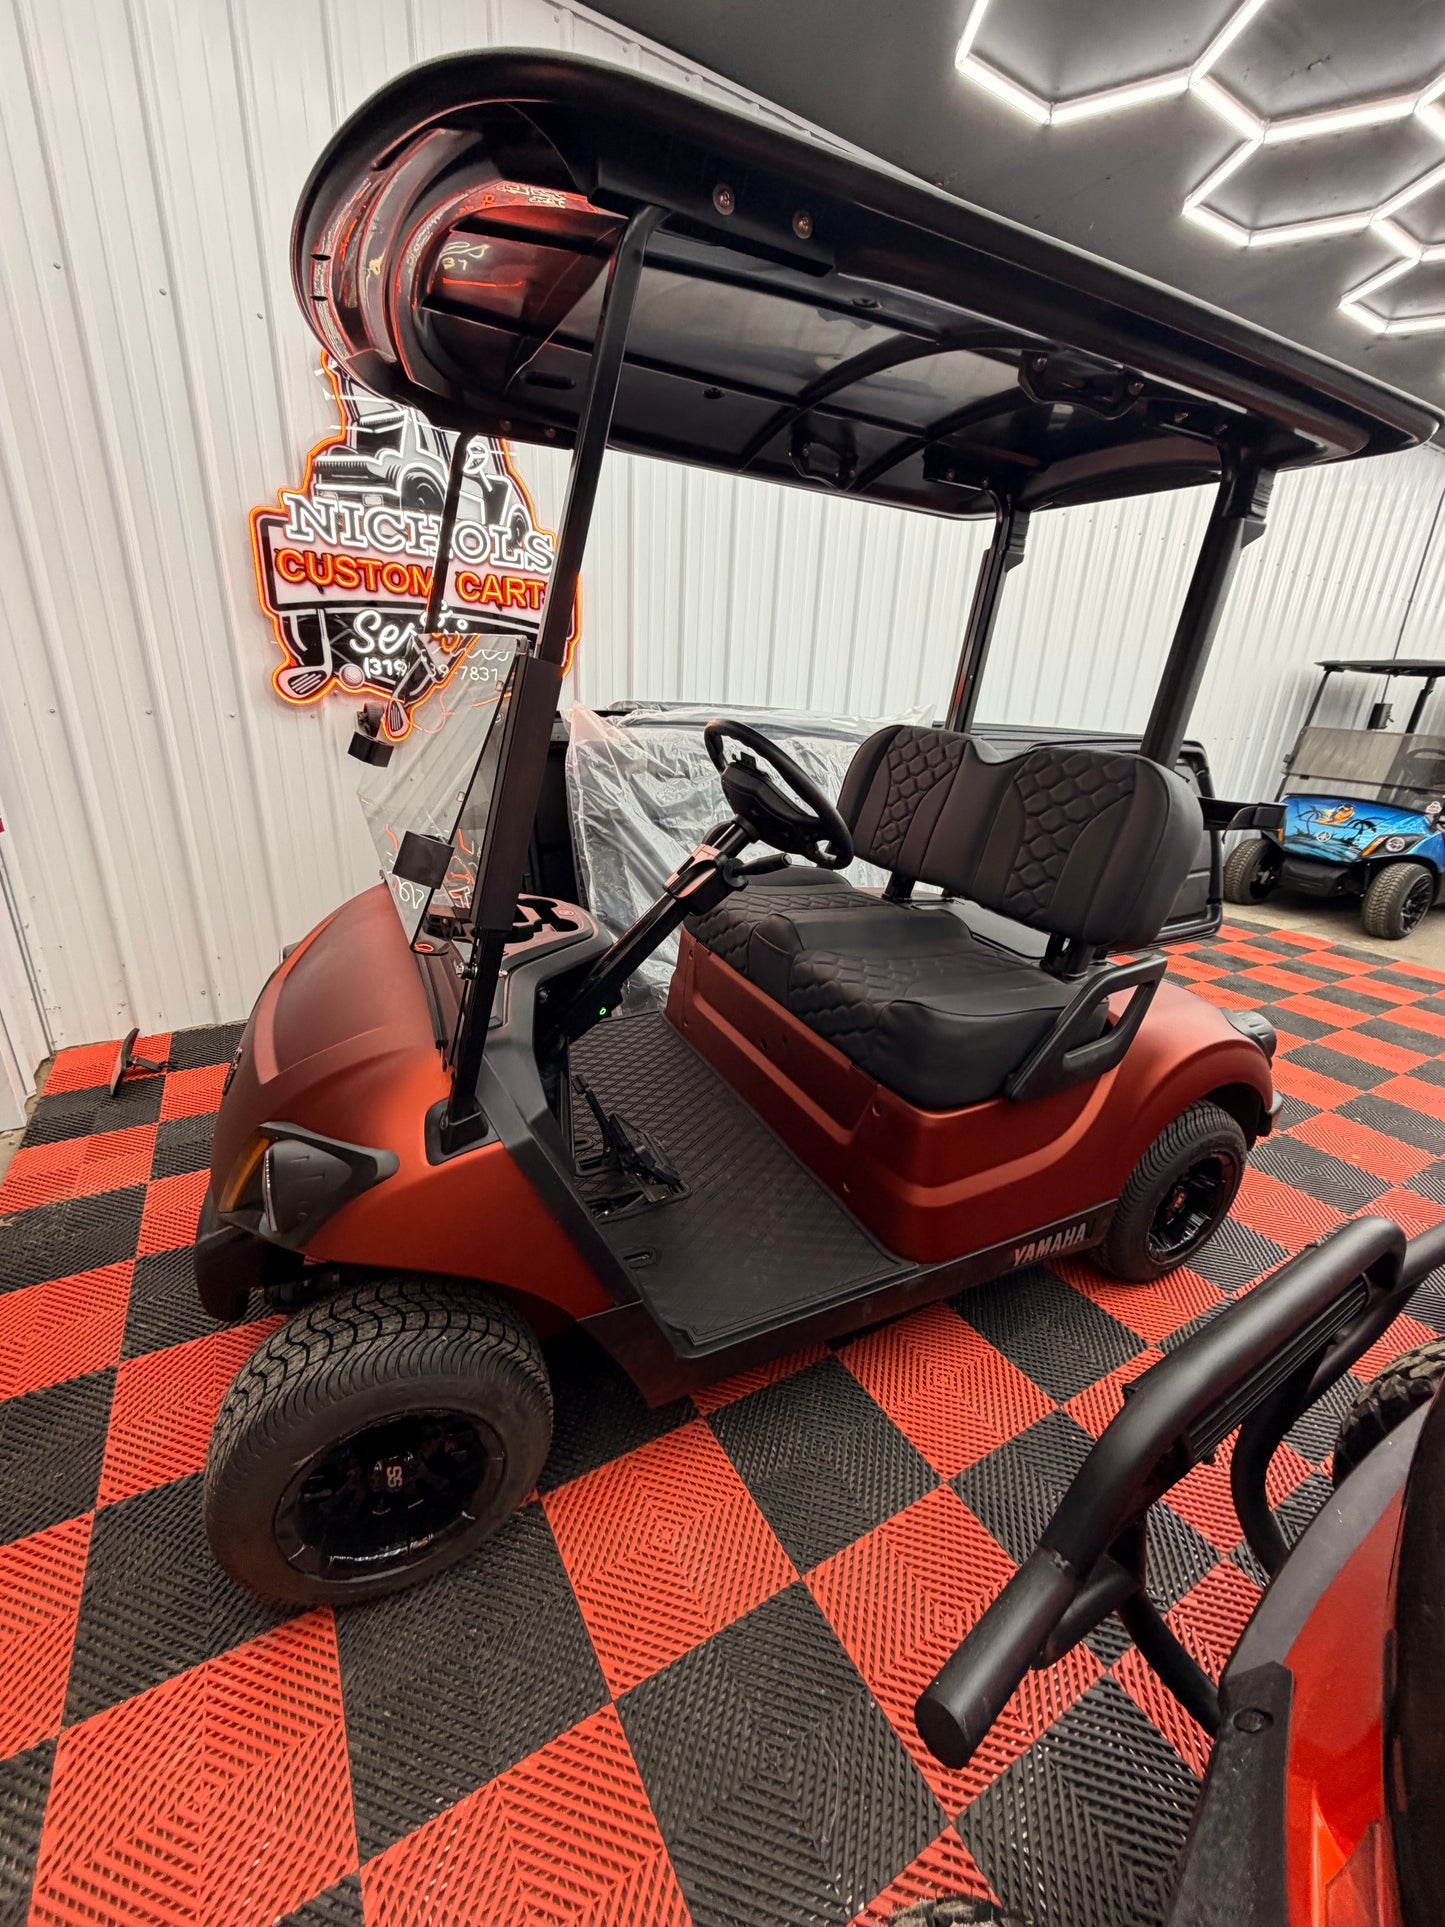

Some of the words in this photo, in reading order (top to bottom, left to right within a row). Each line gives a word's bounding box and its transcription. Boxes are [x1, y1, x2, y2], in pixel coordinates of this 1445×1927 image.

[282, 492, 555, 574] NICHOLS
[274, 547, 434, 597] CUSTOM
[455, 570, 548, 610] CART
[1013, 1222, 1087, 1267] YAMAHA
